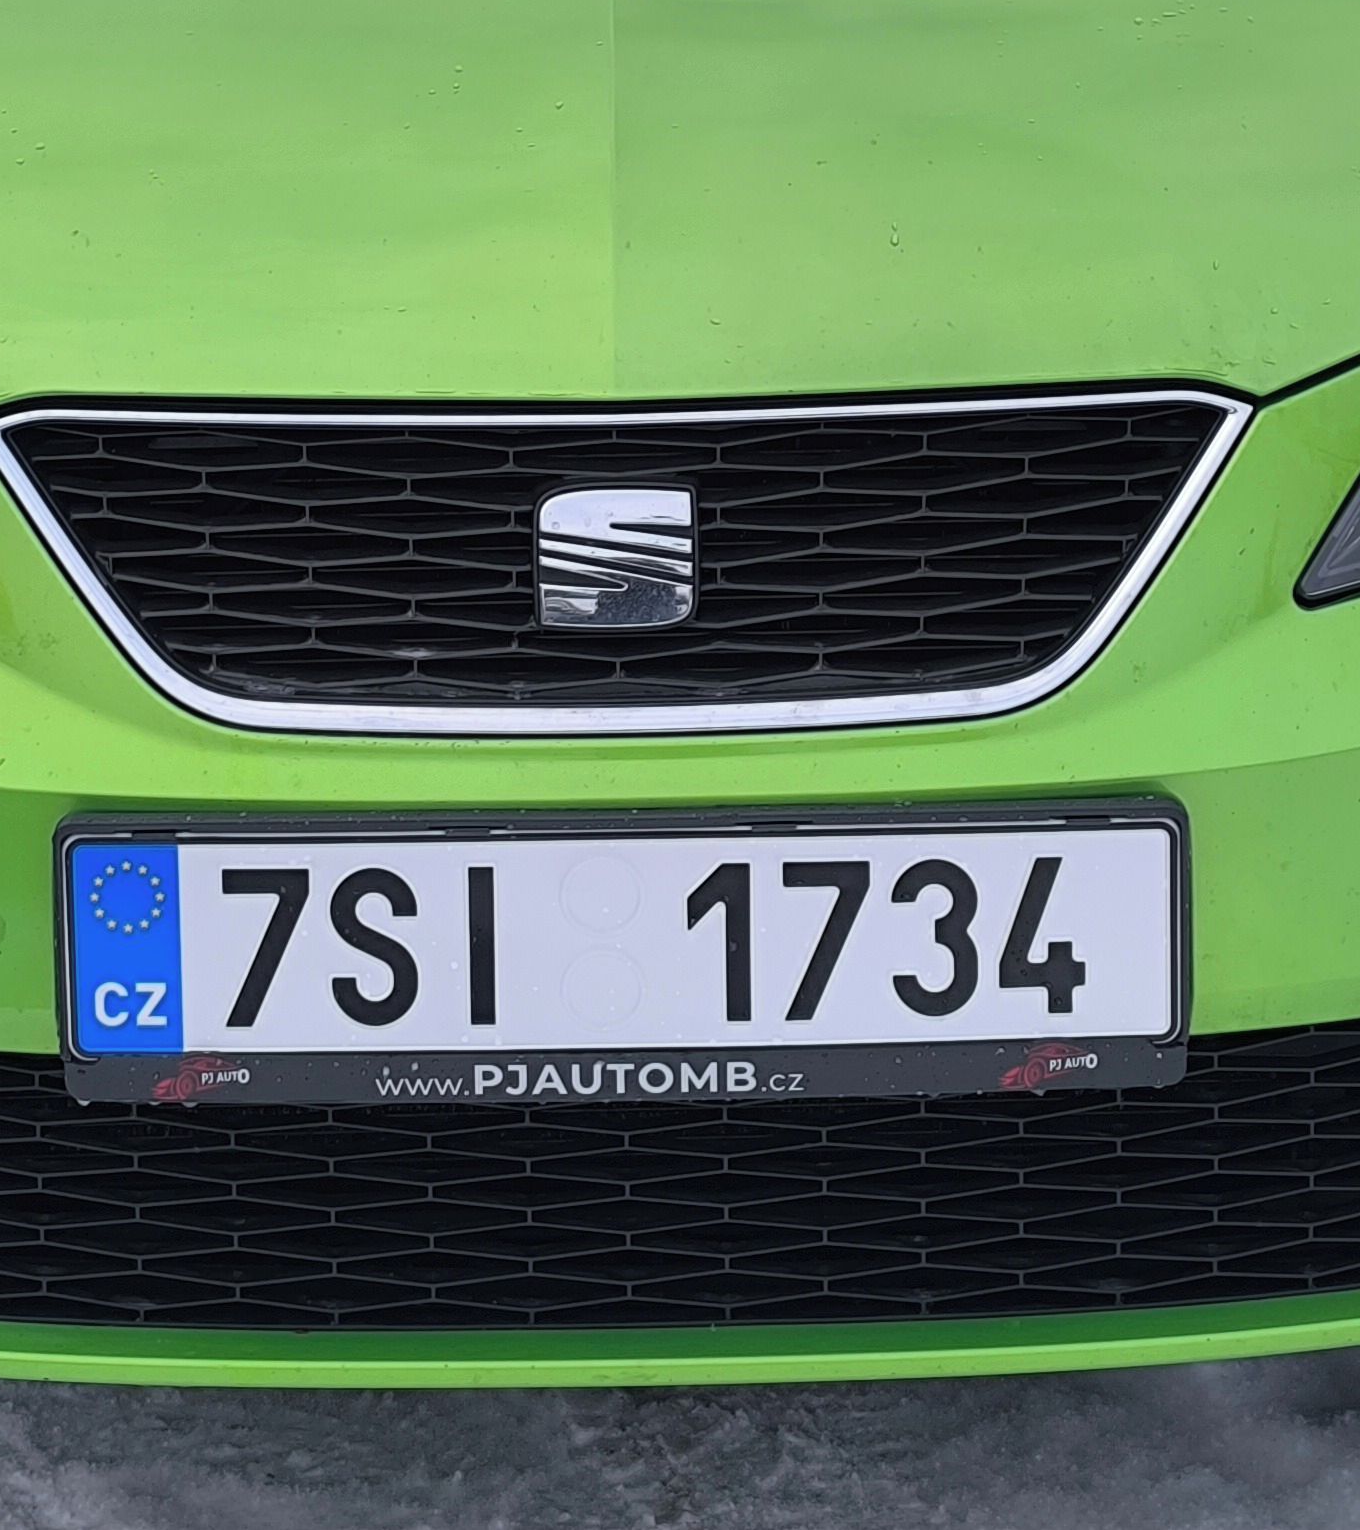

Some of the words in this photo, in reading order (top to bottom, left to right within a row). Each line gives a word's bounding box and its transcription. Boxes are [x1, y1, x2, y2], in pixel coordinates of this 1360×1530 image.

[221, 866, 497, 1028] 7SI
[686, 856, 1086, 1022] 1734
[94, 981, 168, 1027] CZ
[201, 1071, 214, 1085] PJ
[216, 1068, 250, 1084] AUTO
[375, 1060, 805, 1096] www.PJAUTOMB.cz
[1049, 1058, 1062, 1071] PJ
[1064, 1053, 1098, 1070] AUTO
